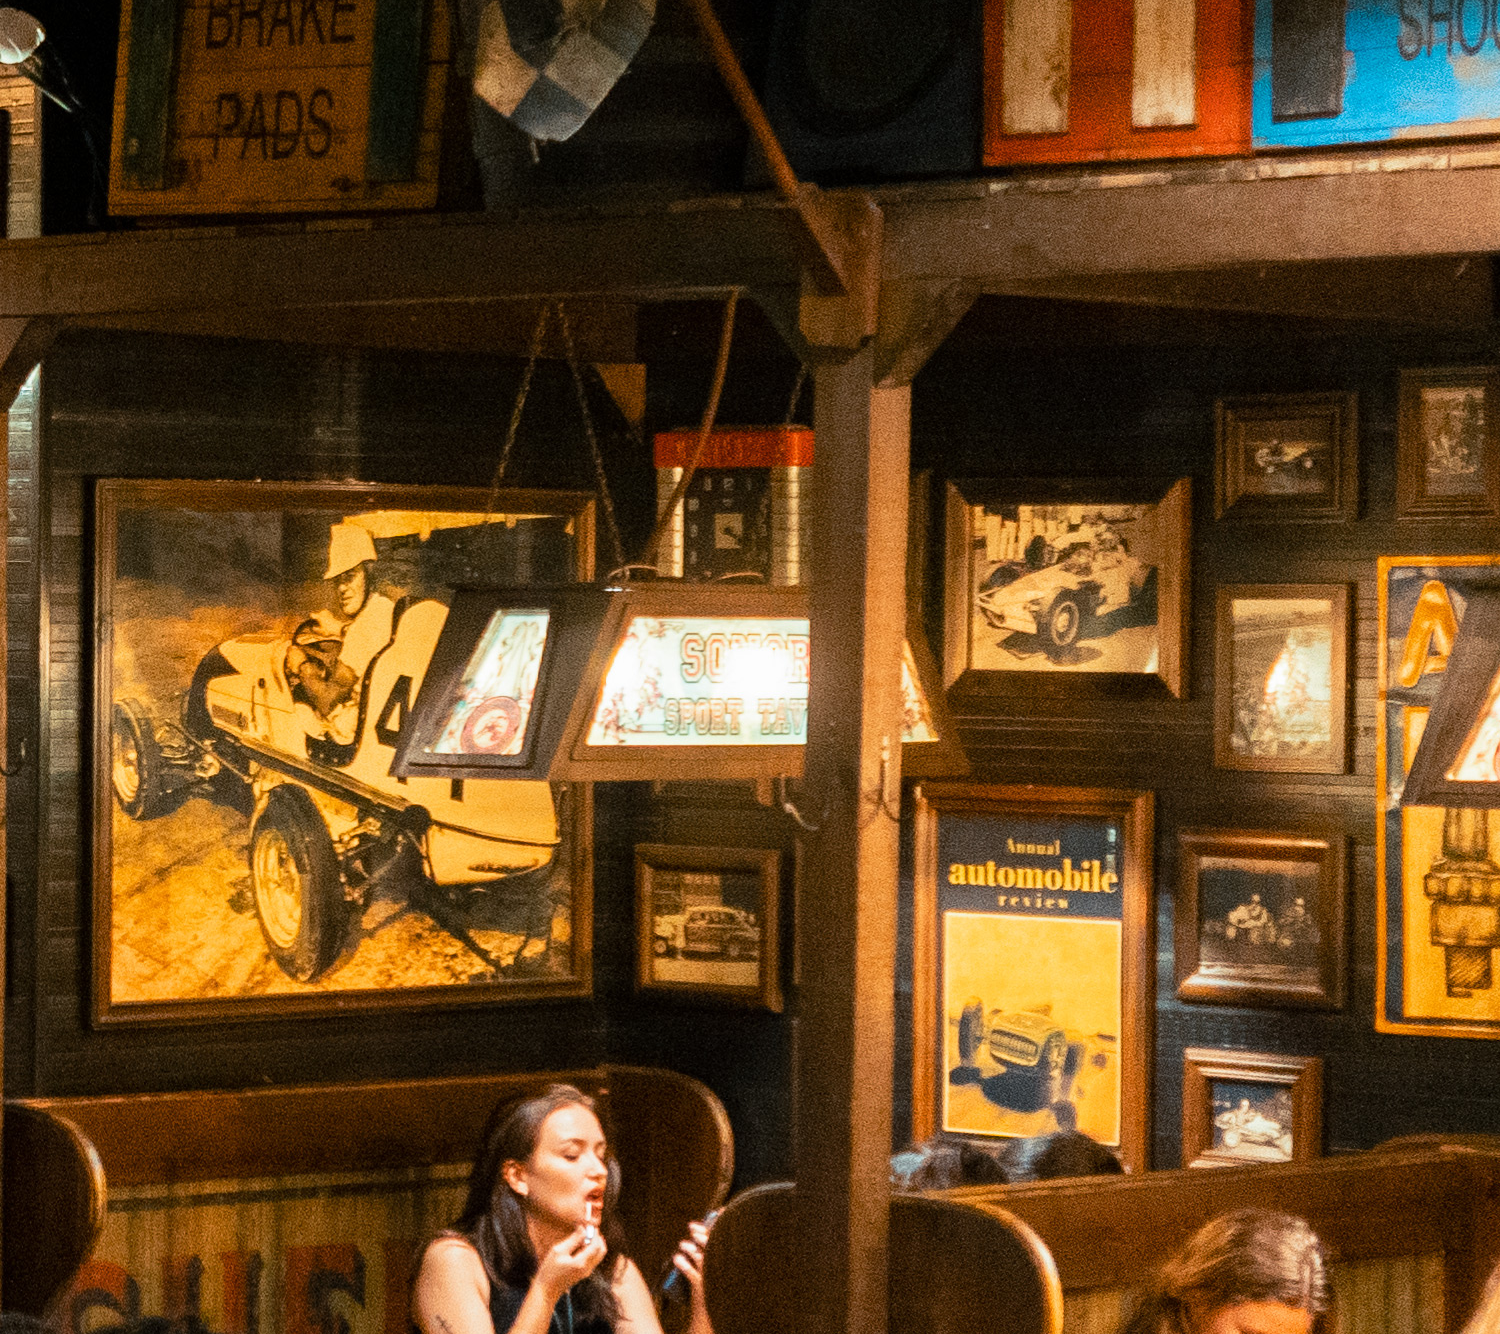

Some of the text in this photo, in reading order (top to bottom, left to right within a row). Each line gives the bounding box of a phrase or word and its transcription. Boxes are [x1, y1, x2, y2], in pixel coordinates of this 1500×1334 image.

[212, 88, 334, 162] PADS
[665, 698, 743, 736] SPORT
[1007, 838, 1060, 856] Annual
[948, 858, 1118, 893] automobile
[998, 893, 1069, 908] review
